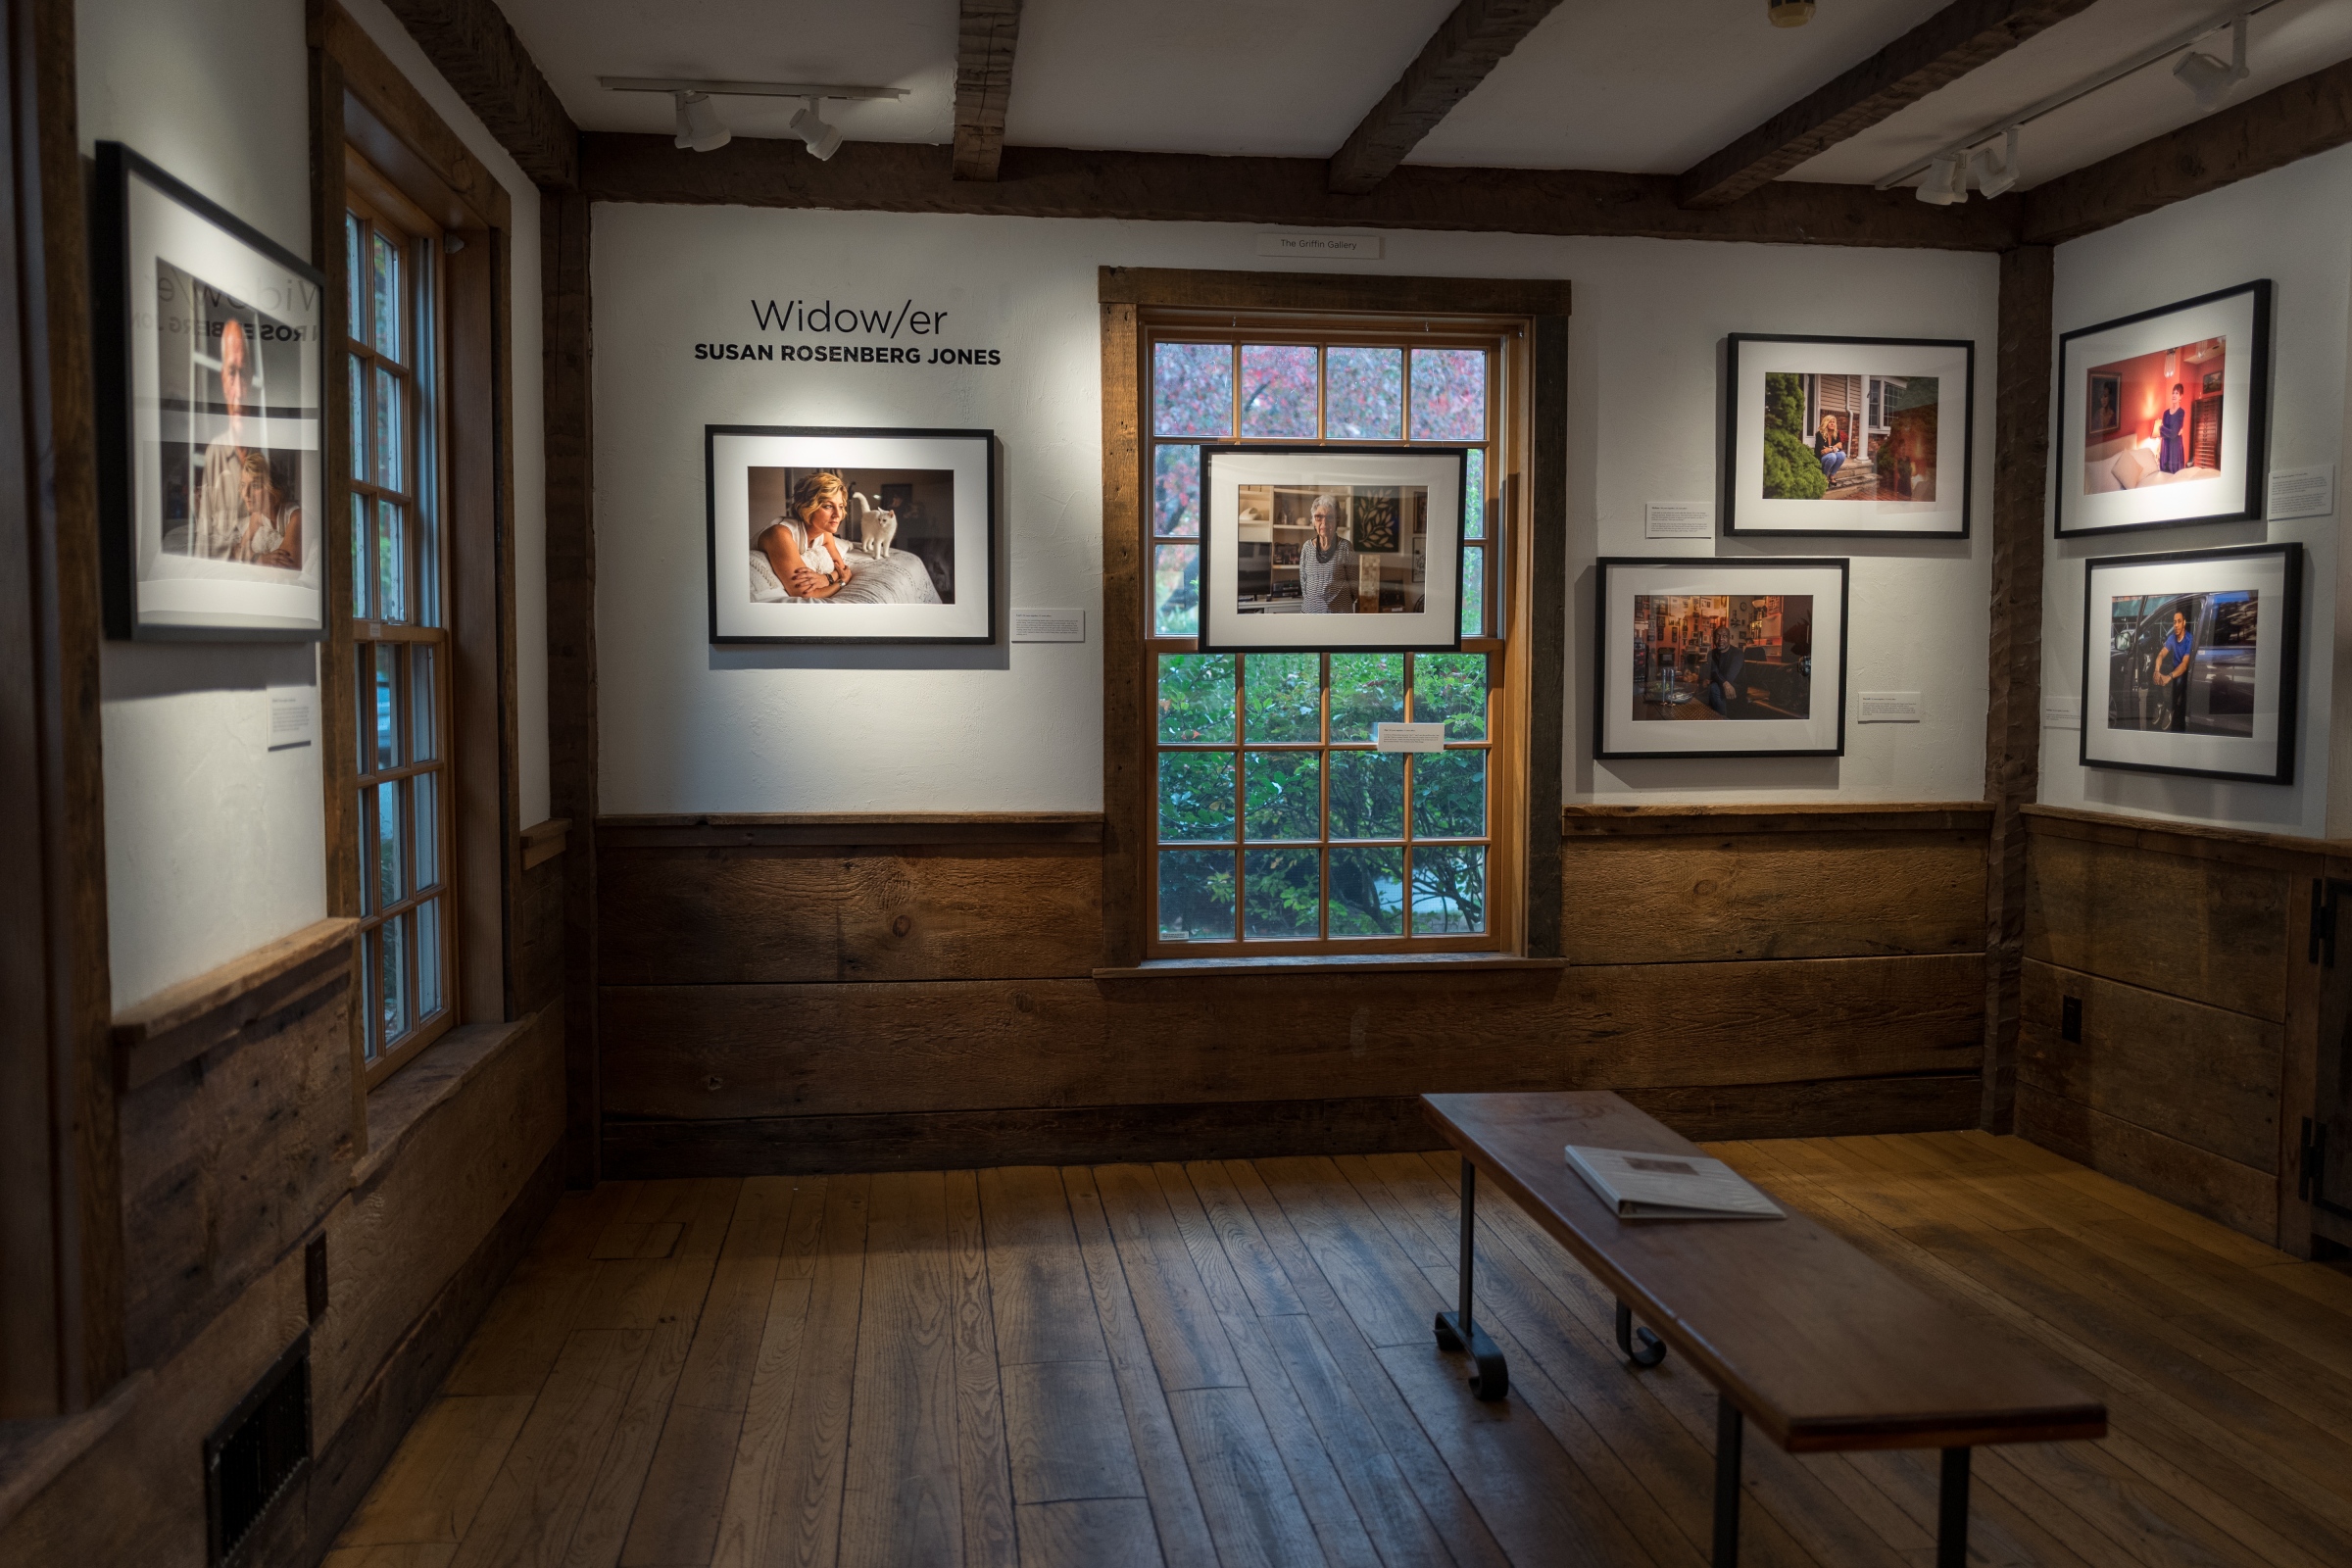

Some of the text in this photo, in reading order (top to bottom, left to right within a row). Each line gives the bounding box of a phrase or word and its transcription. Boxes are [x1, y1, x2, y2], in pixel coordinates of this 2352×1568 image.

[1298, 239, 1325, 248] Griffin
[1328, 241, 1357, 250] Gallery
[751, 299, 948, 339] Widow/er
[694, 343, 1002, 366] SUSAN ROSENBERG JONES
